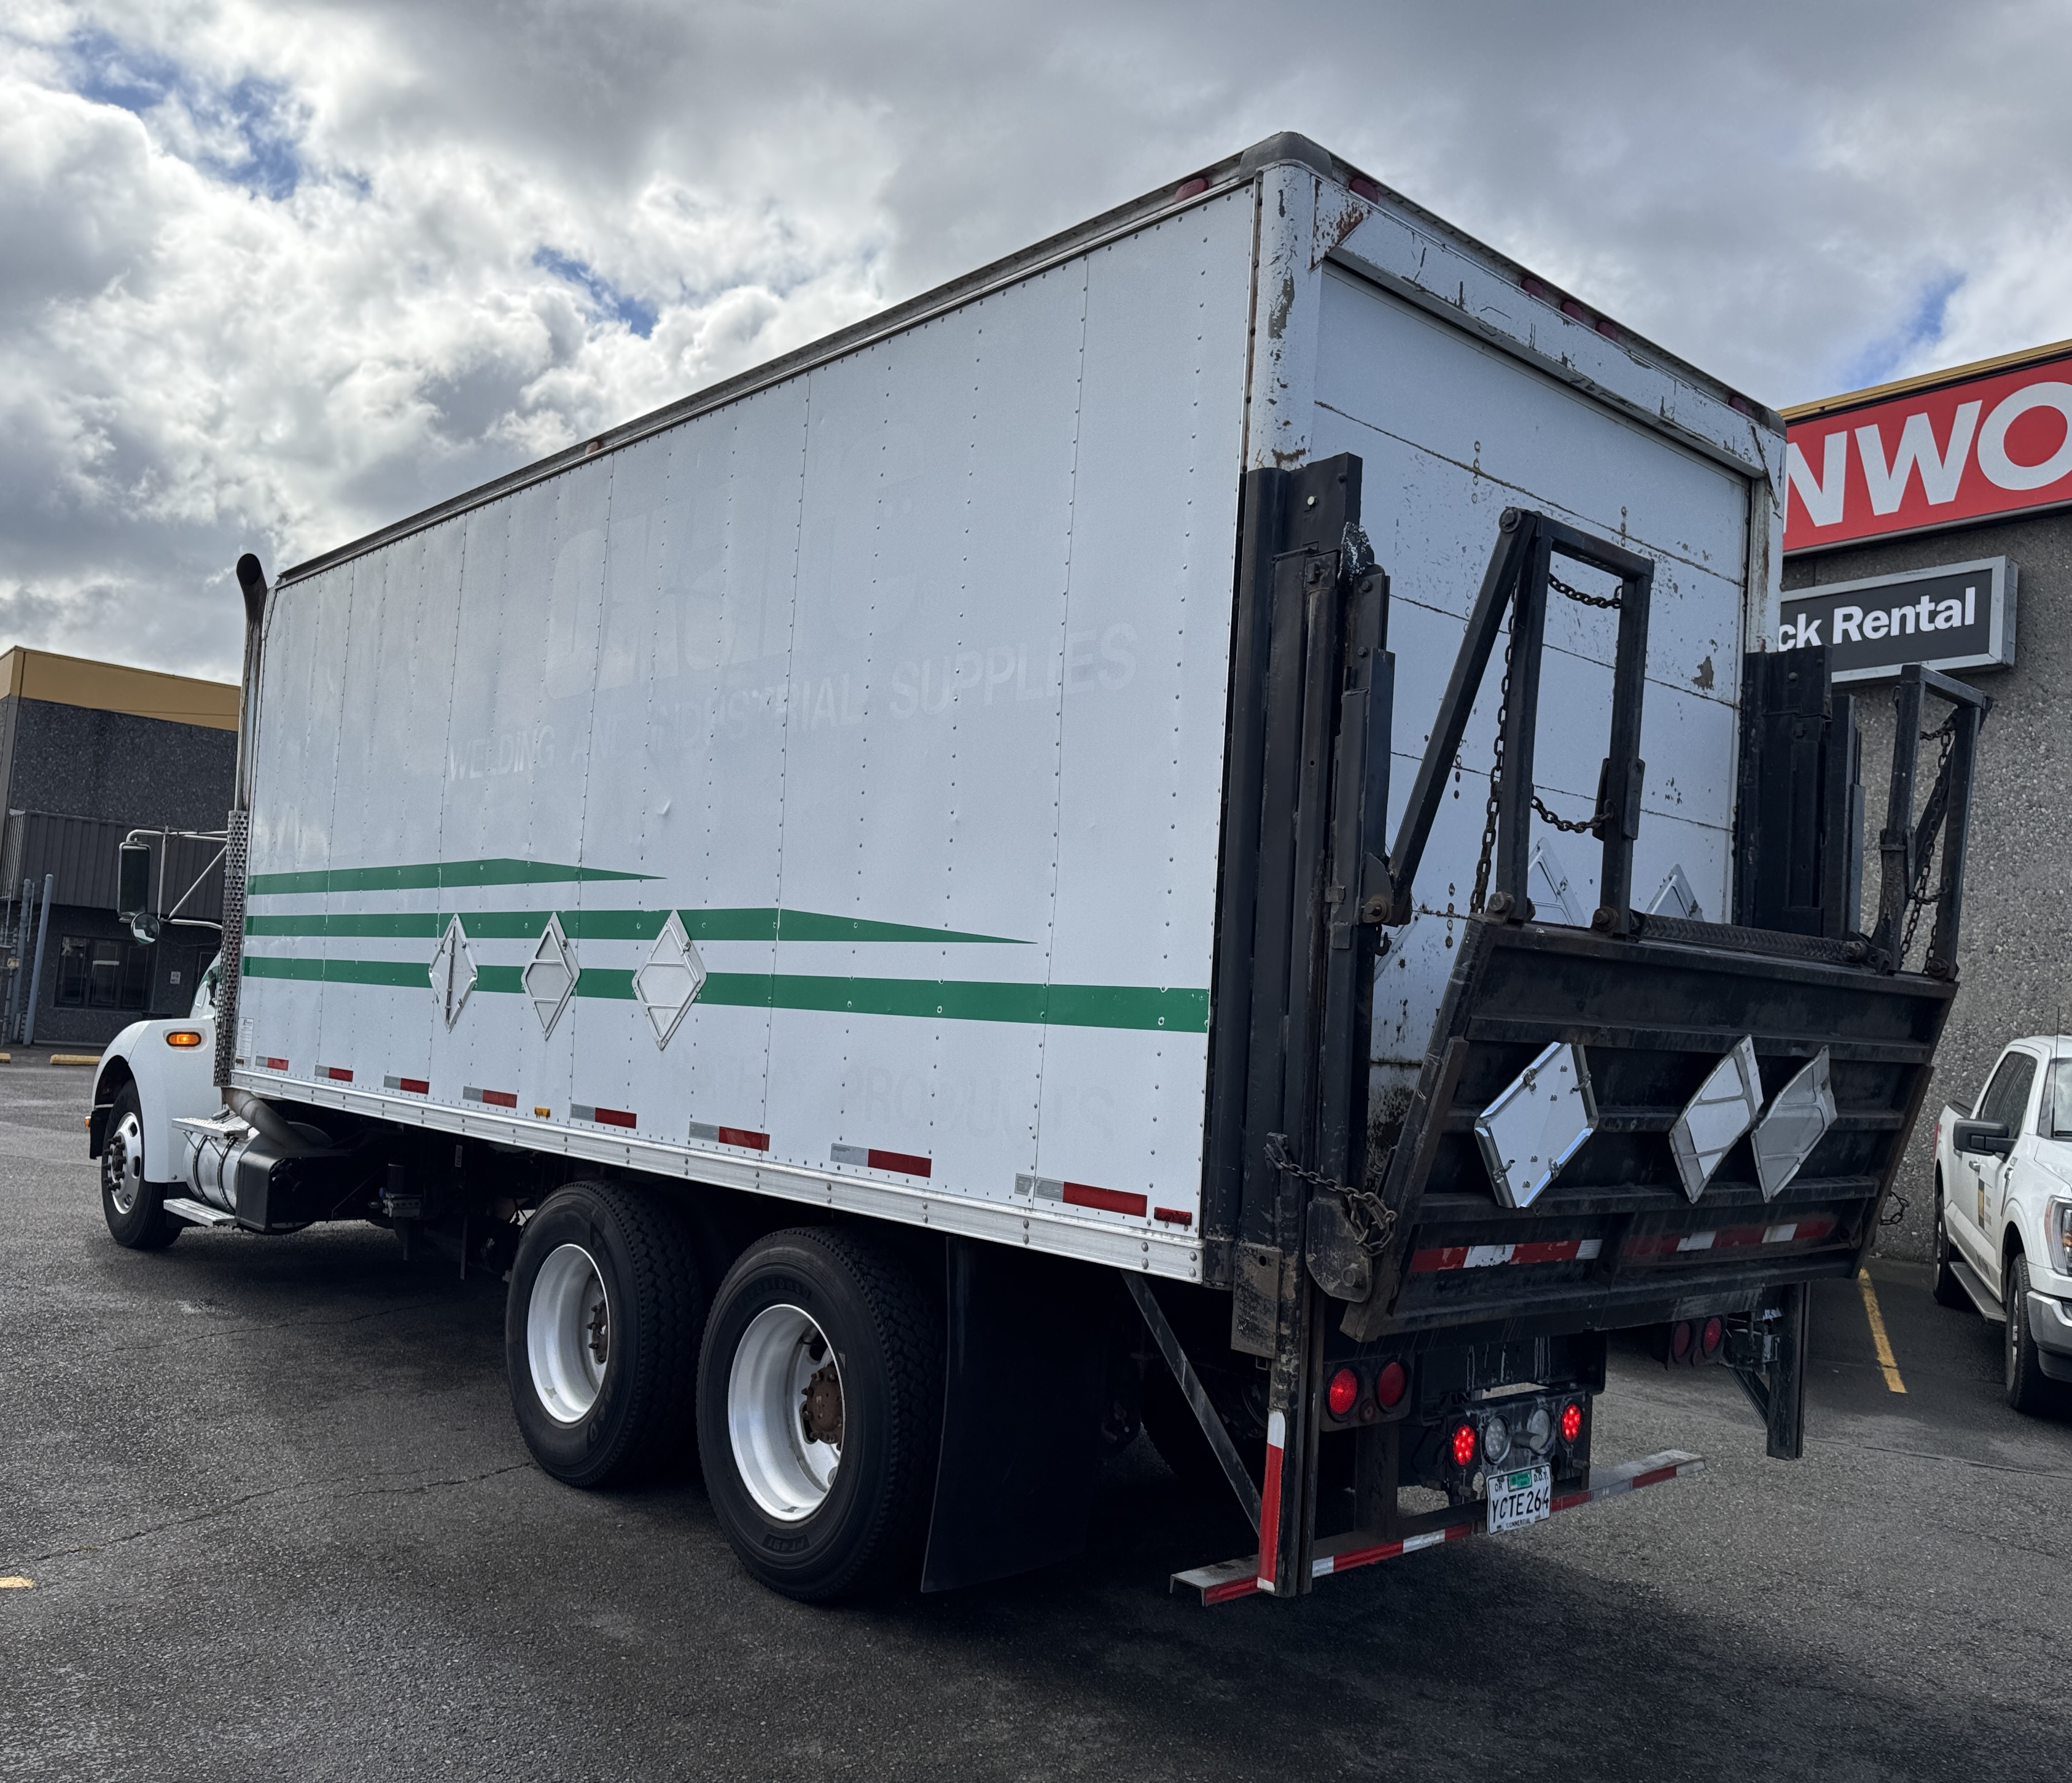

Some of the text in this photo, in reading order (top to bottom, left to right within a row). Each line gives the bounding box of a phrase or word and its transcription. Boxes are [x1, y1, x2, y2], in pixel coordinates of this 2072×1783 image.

[1832, 586, 1976, 645] Rental
[448, 724, 555, 781] WELDING
[890, 621, 1137, 720] SUPPLIES
[1494, 1483, 1503, 1492] OR
